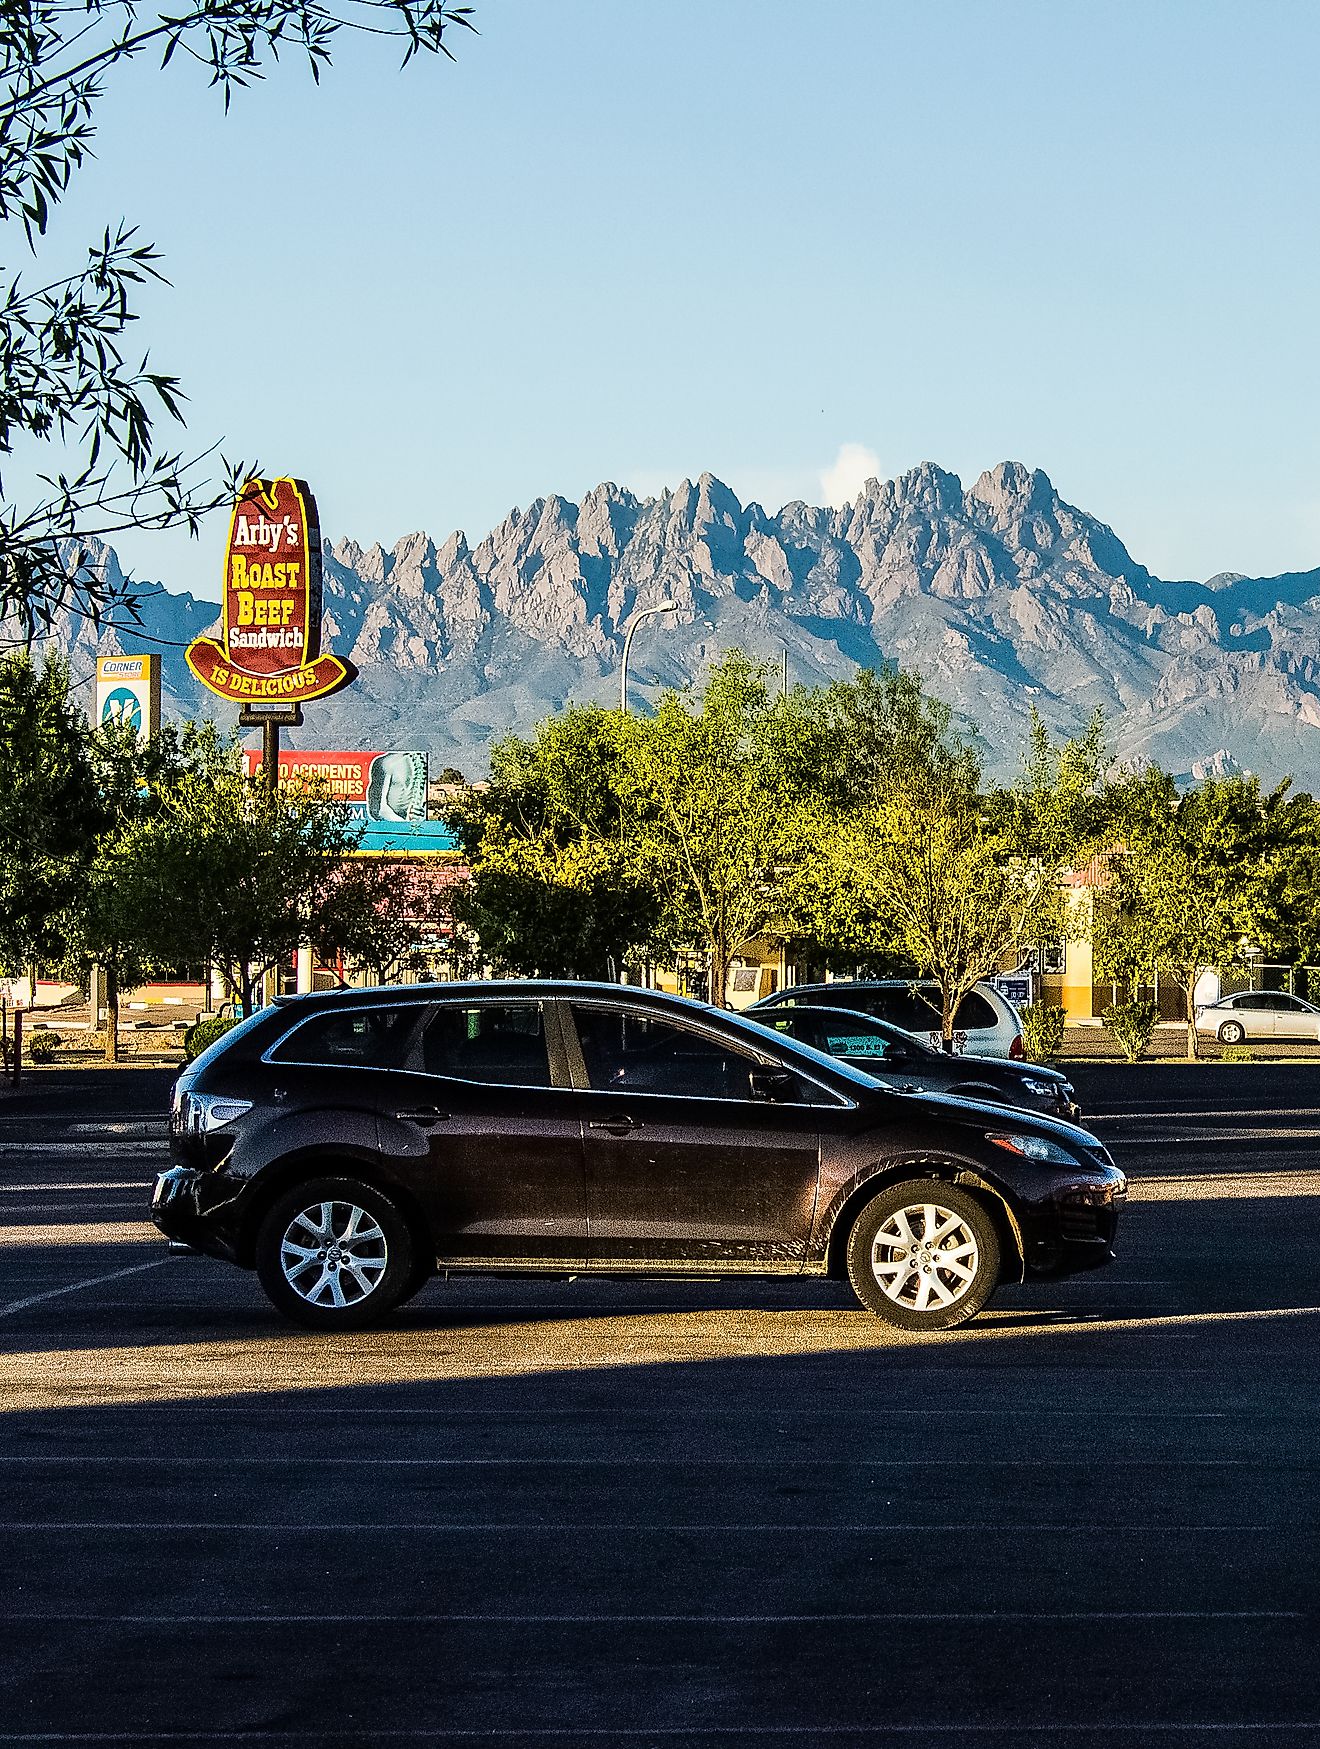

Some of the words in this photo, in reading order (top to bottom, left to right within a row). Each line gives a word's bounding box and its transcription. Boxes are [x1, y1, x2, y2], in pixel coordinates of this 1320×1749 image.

[231, 554, 300, 589] ROAST
[237, 591, 295, 626] BEEF
[229, 627, 304, 648] Sandwich
[103, 661, 143, 672] CORNER
[209, 664, 230, 686] IS
[291, 763, 362, 779] ACCIDENTS
